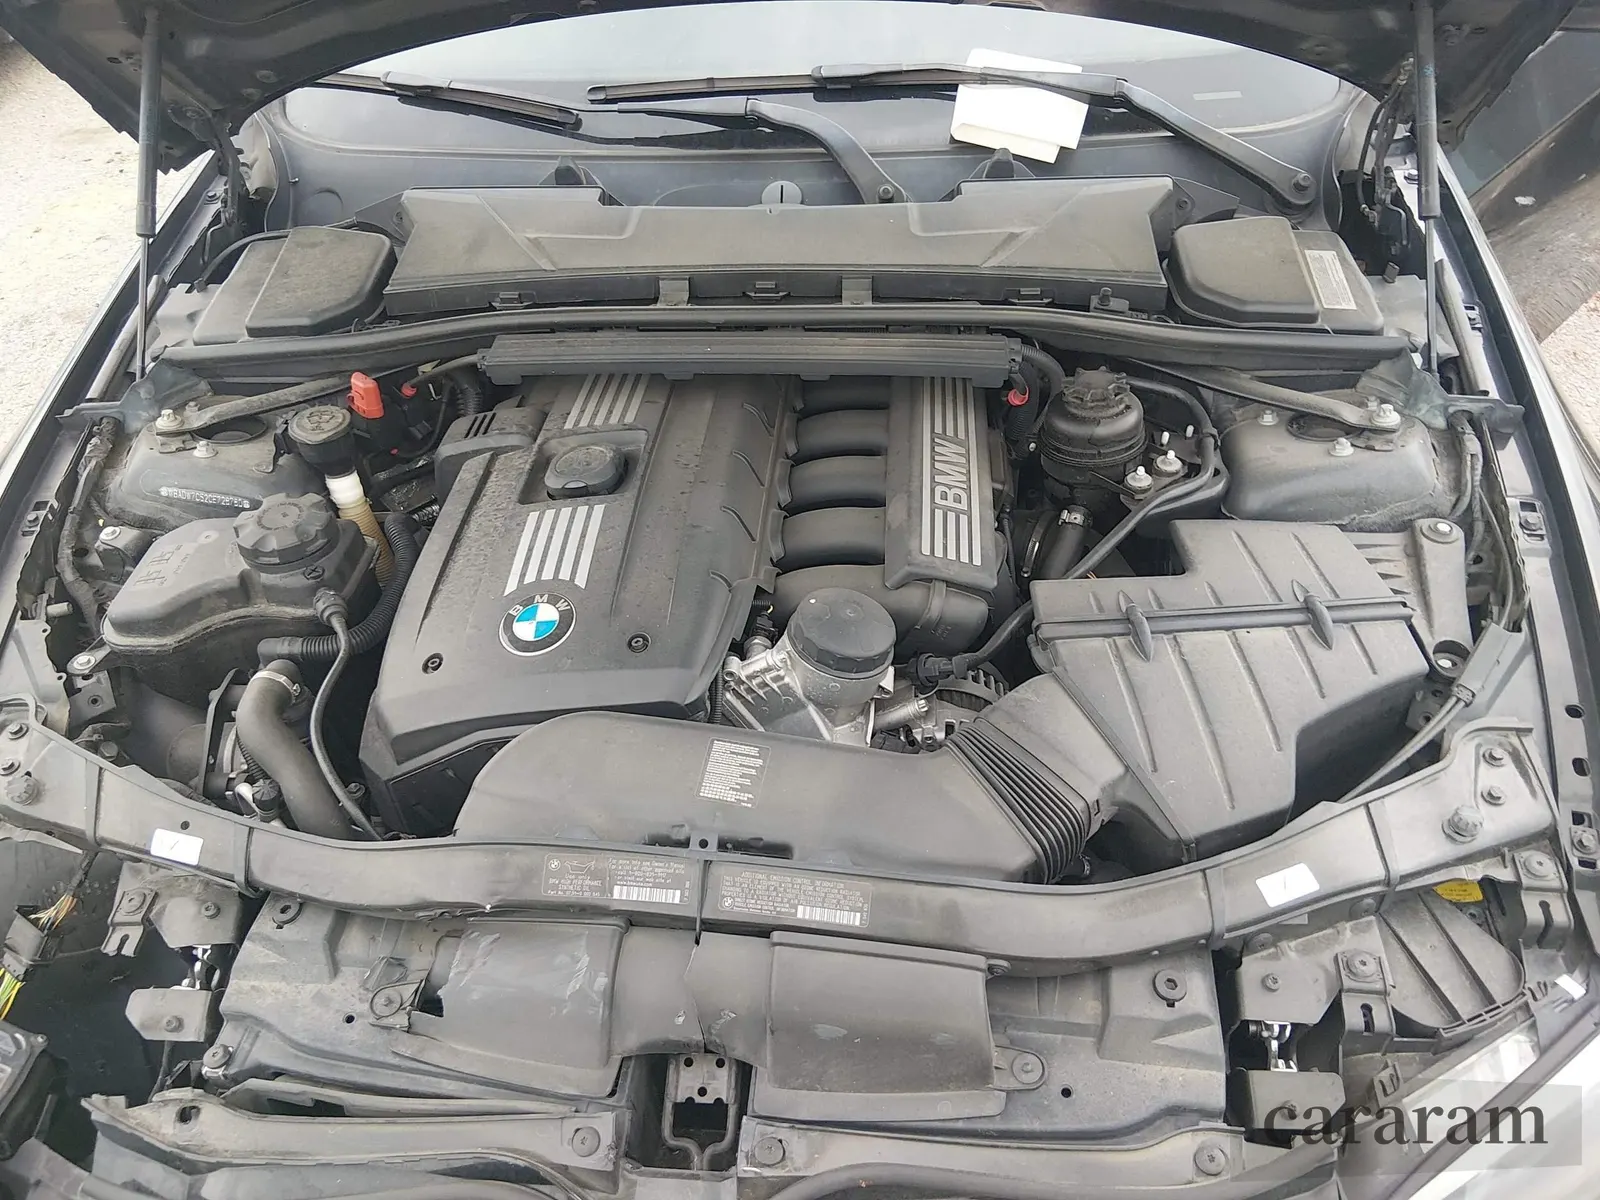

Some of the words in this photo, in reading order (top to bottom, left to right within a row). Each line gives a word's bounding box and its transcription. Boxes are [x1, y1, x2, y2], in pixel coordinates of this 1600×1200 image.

[934, 437, 968, 511] BMW
[508, 594, 571, 616] BMW
[741, 871, 768, 880] ADDITIONAL
[770, 874, 792, 883] EMISSION
[792, 877, 812, 885] CONTROL
[816, 880, 845, 889] INFORMATION
[816, 886, 839, 894] REDUCTION
